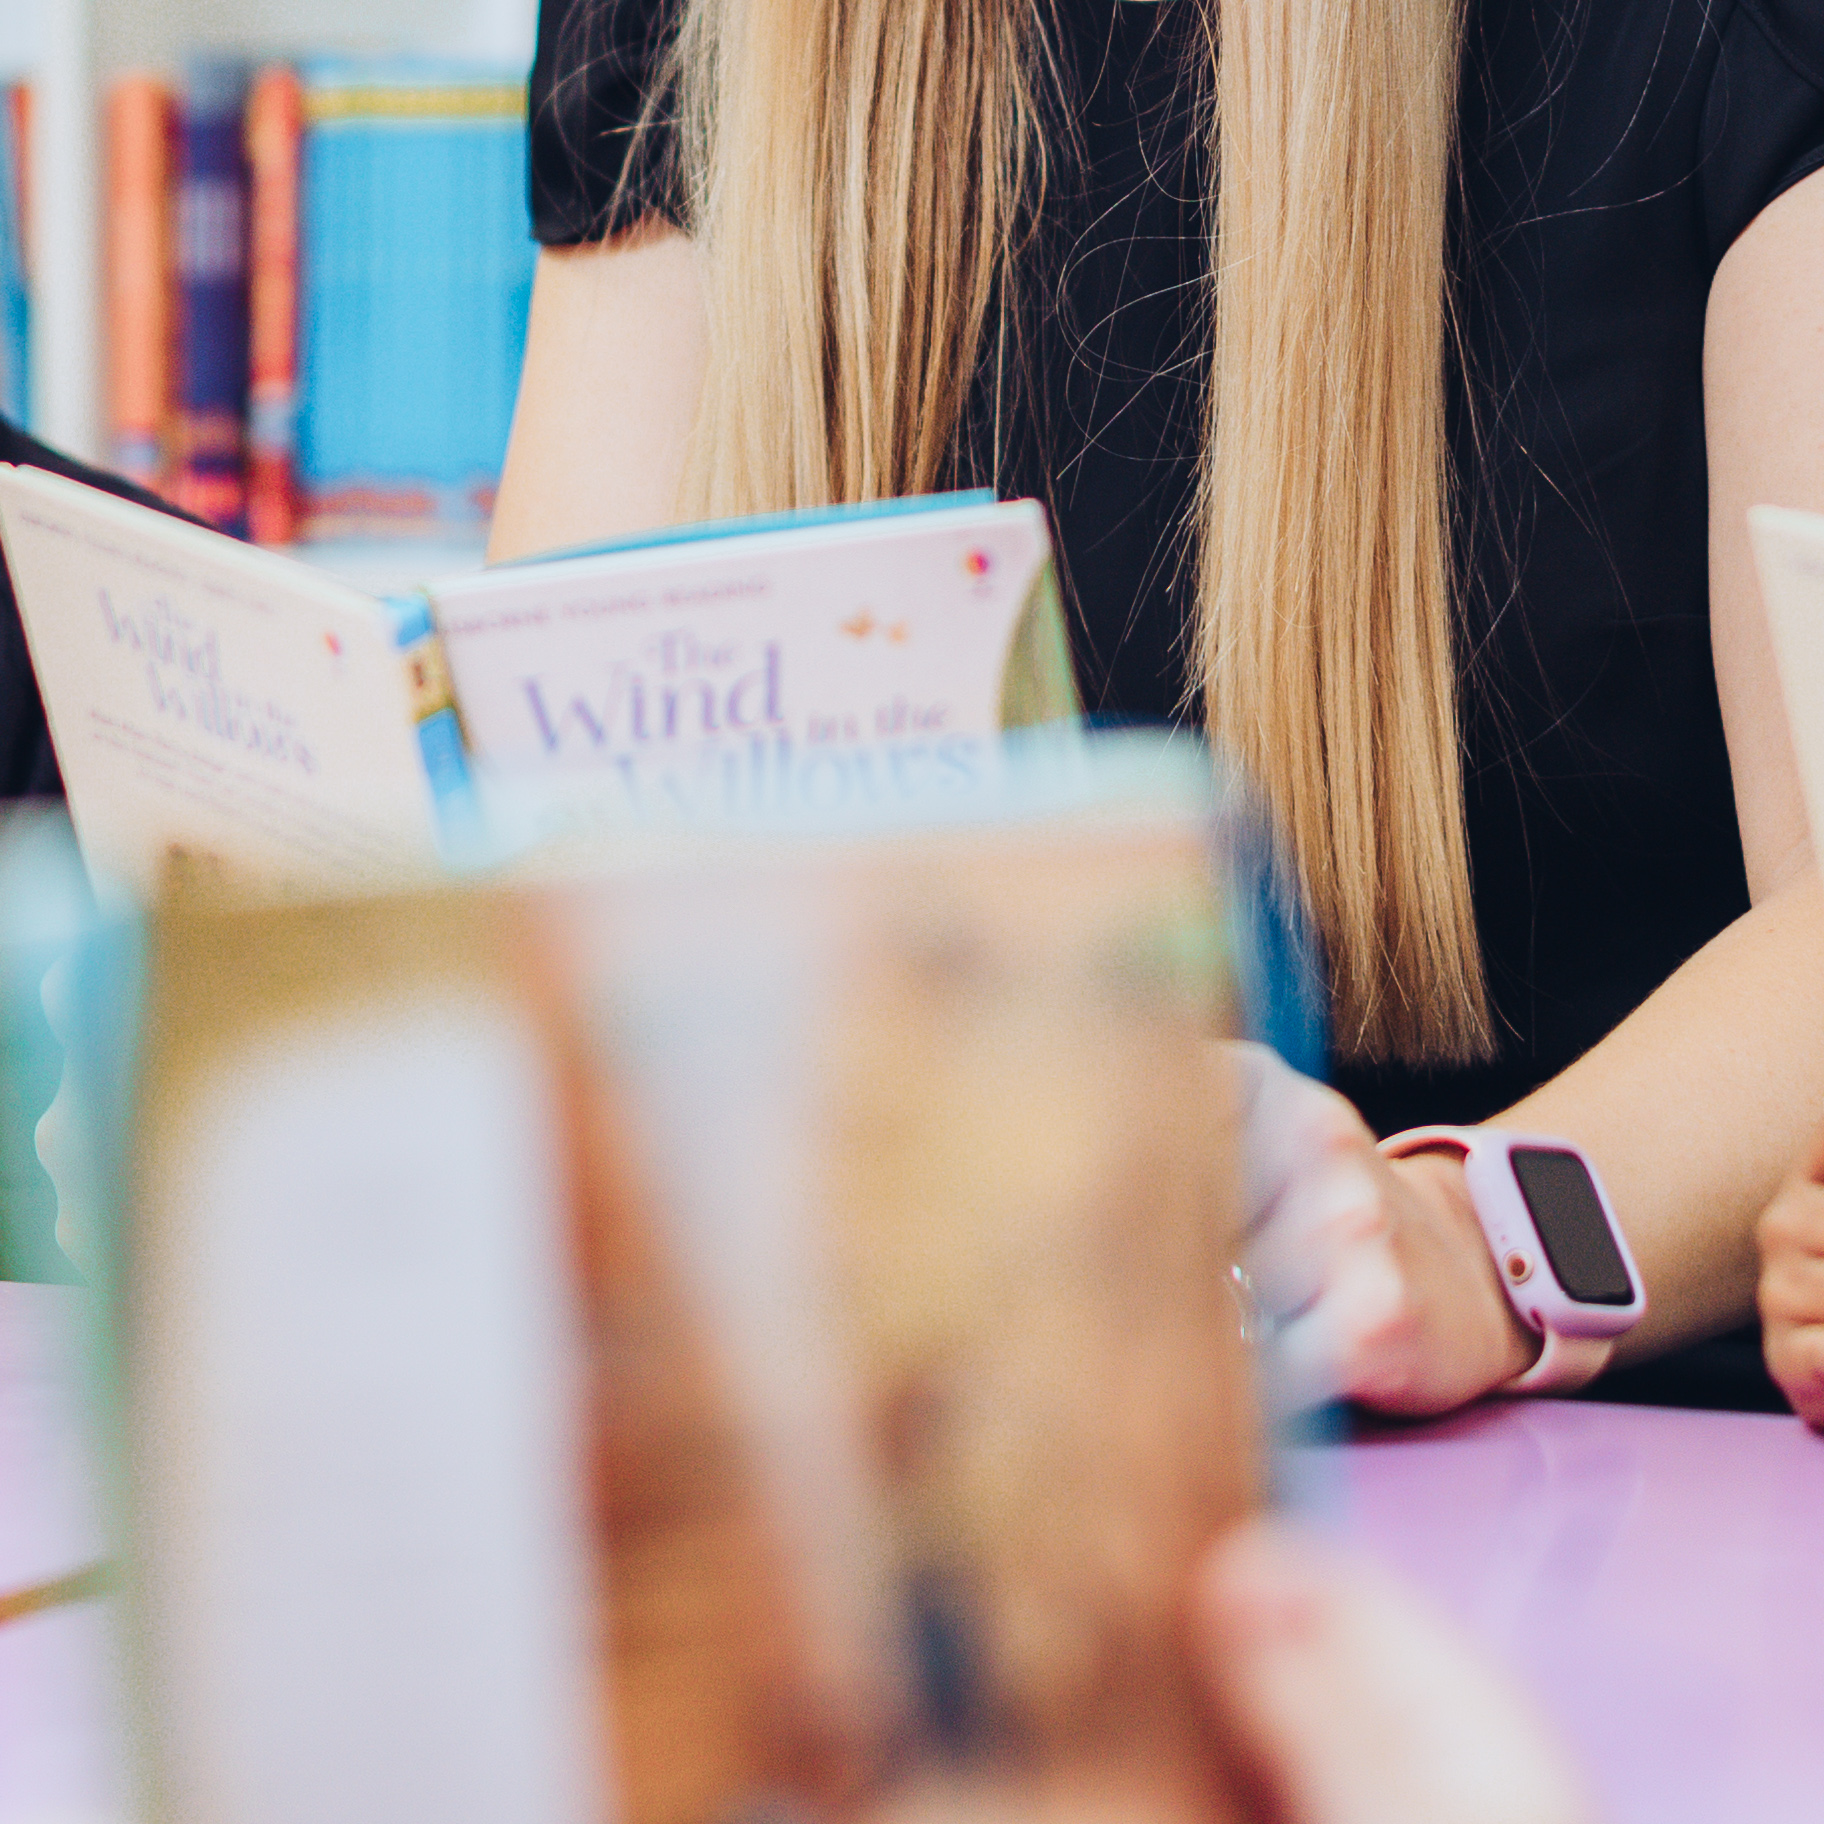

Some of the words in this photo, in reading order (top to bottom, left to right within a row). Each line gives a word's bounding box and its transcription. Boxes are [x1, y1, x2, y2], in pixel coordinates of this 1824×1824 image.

[646, 624, 736, 672] The
[521, 639, 786, 754] Wind
[874, 692, 950, 735] the
